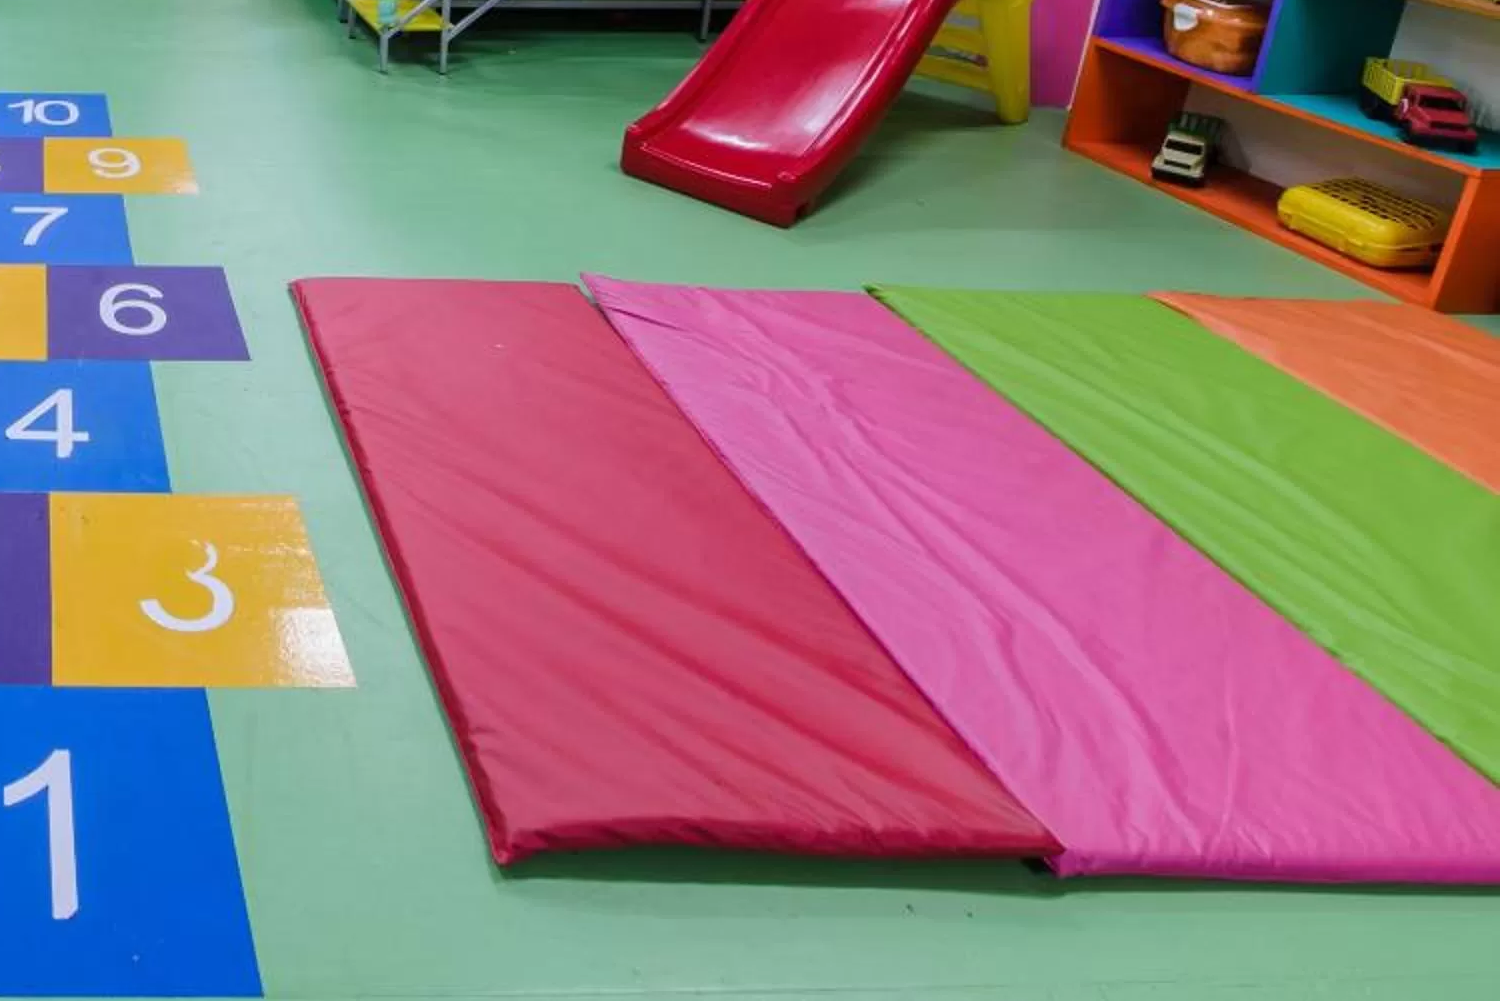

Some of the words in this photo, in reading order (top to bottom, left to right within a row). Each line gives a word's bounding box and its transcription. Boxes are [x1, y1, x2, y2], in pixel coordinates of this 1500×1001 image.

[11, 100, 79, 125] 10
[88, 147, 142, 179] 9
[14, 206, 68, 245] 7
[98, 281, 171, 337] 6
[6, 389, 89, 458] 4
[139, 540, 236, 633] 3
[4, 750, 77, 919] 1
